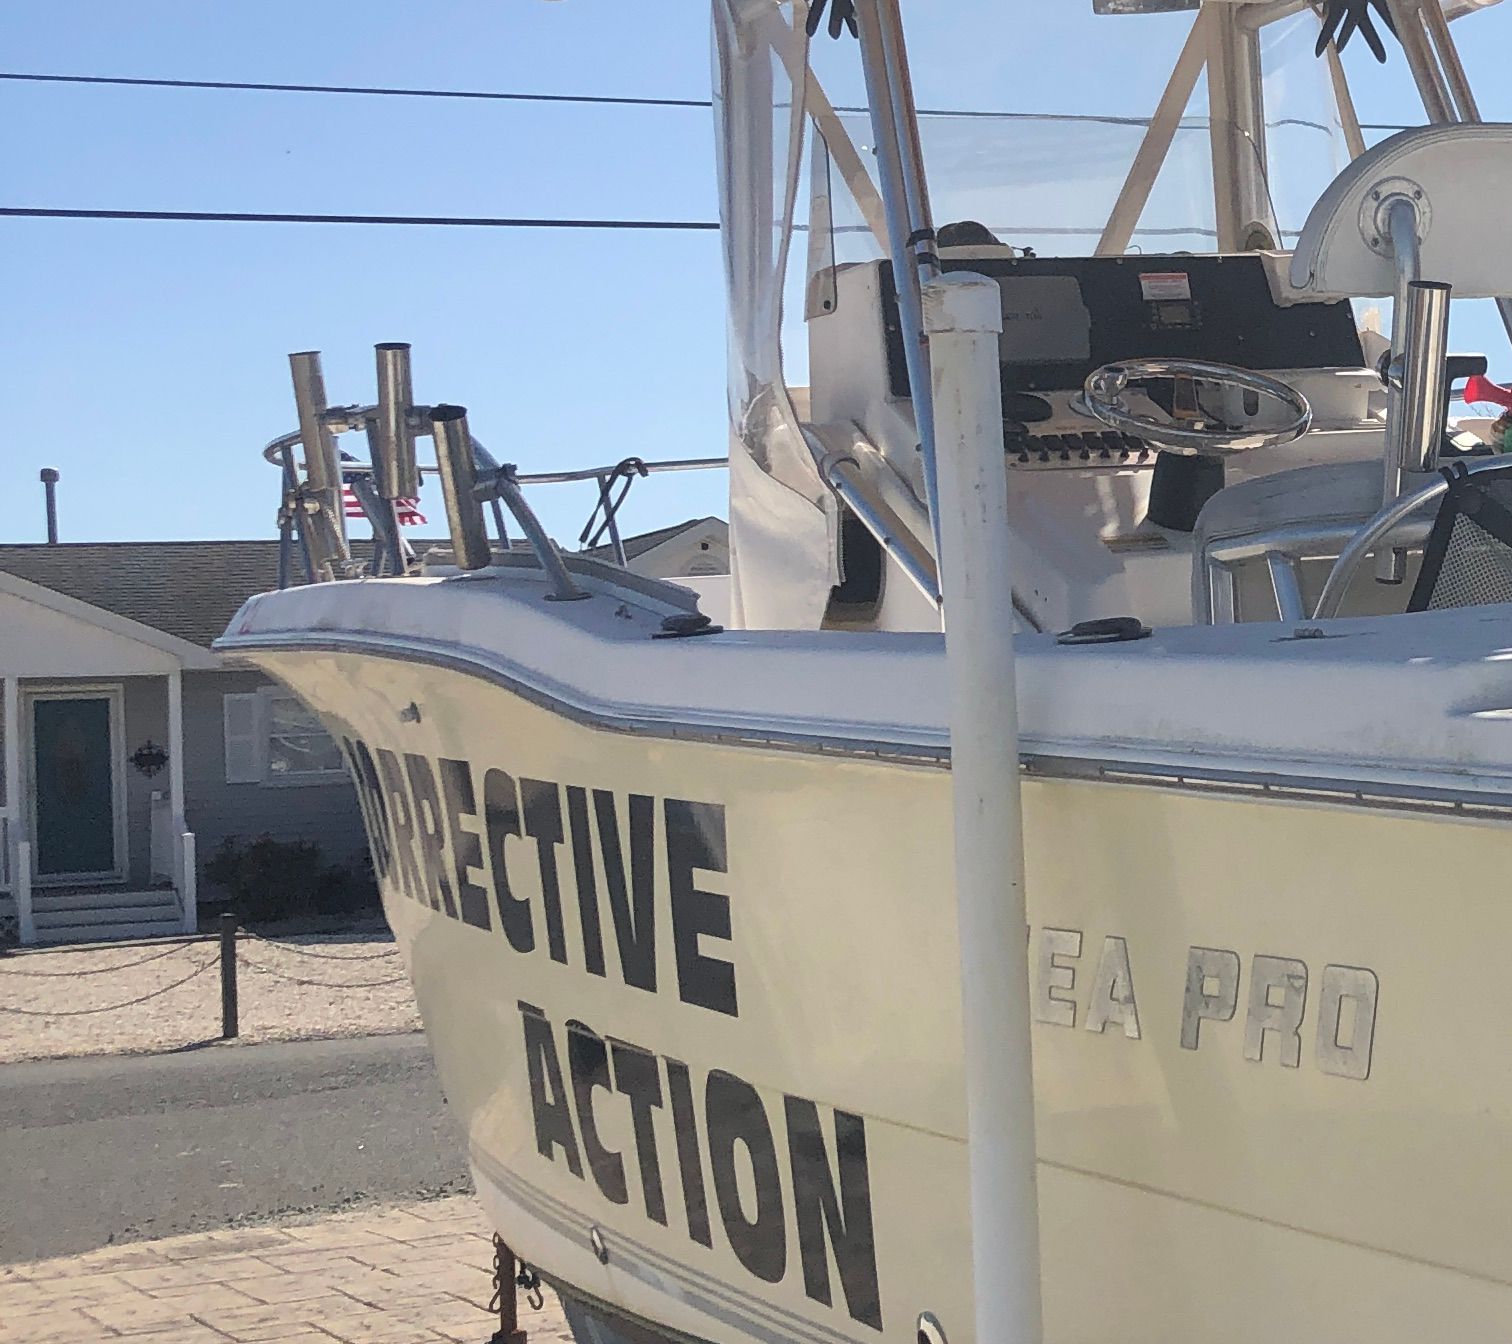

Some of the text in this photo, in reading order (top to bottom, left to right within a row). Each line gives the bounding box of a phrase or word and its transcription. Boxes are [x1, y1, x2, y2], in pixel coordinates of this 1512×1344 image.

[1026, 923, 1380, 1082] EA PRO
[518, 999, 884, 1333] ACTION
